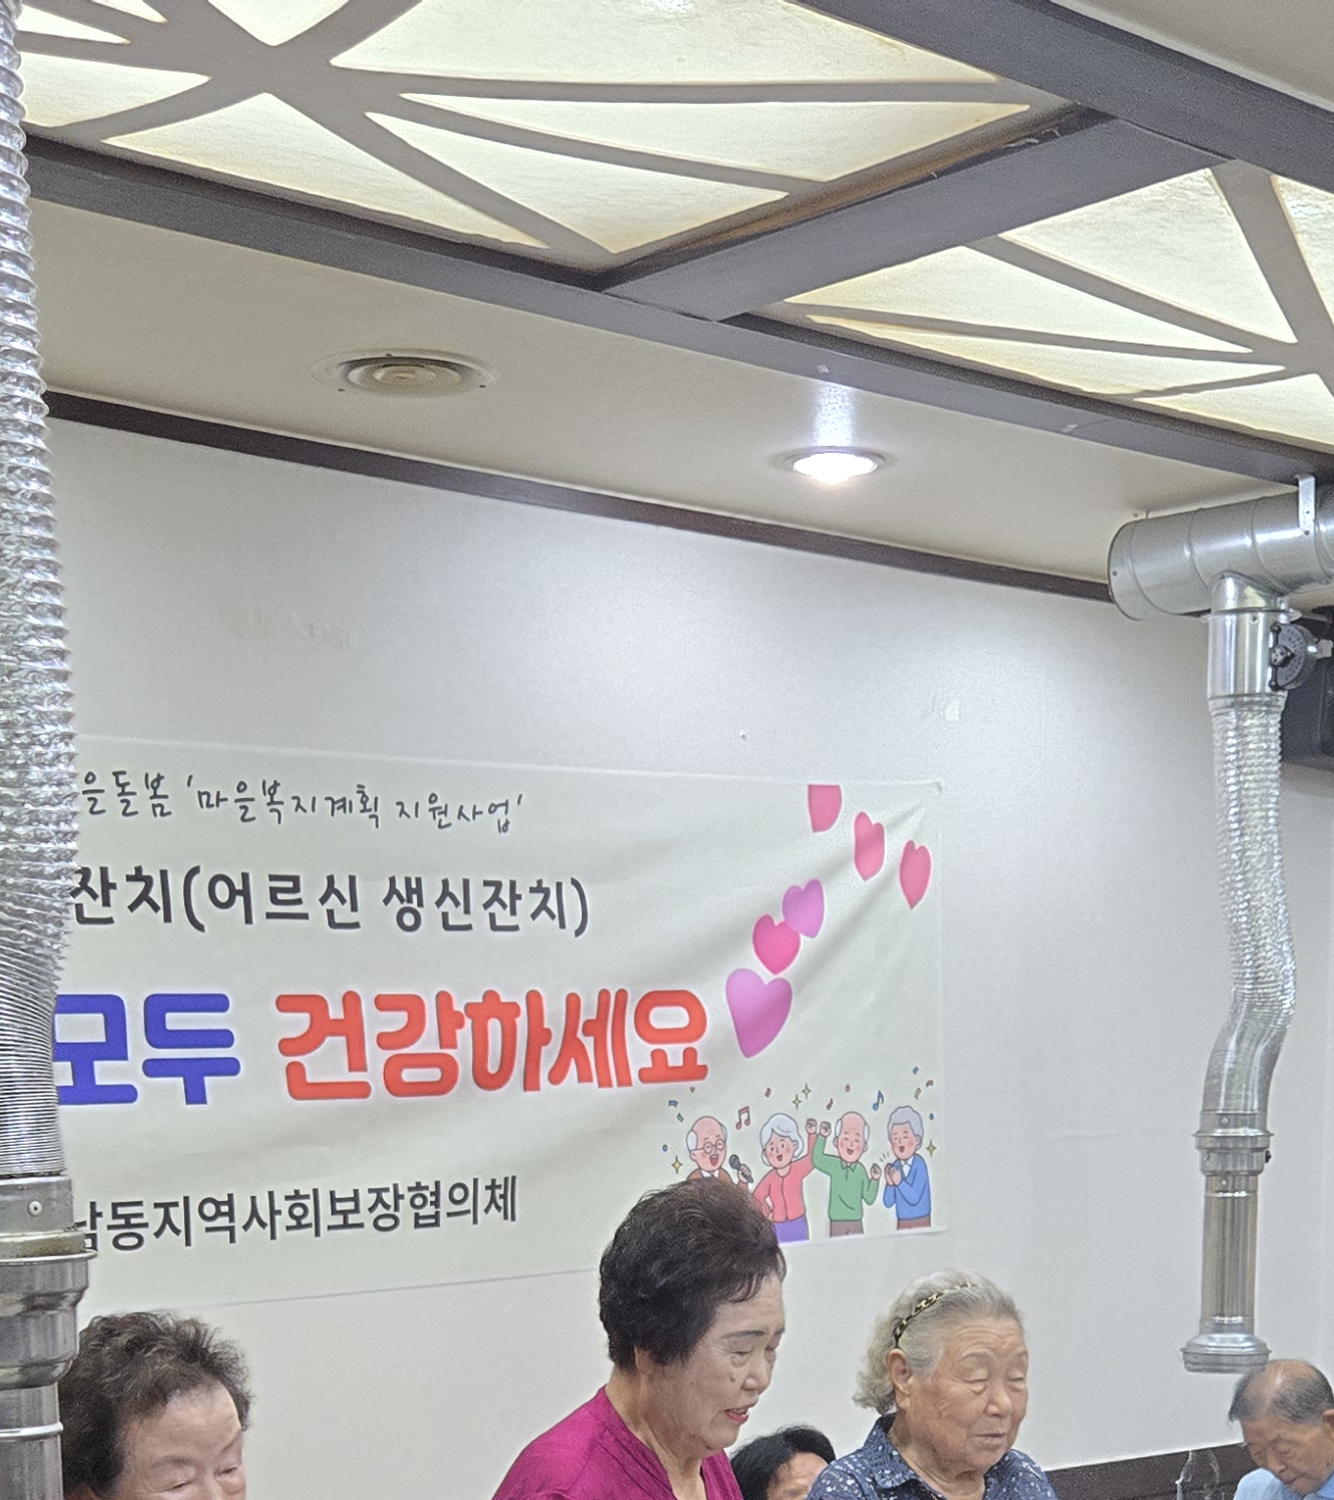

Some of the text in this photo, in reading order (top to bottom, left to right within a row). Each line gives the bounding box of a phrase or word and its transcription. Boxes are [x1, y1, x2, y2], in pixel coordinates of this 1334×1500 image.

[81, 771, 524, 834] 을돌봄 '마을복지계획 지원사업'
[382, 874, 590, 939] 생신잔치)
[51, 992, 242, 1106] 모두
[275, 987, 710, 1101] 건강하세요
